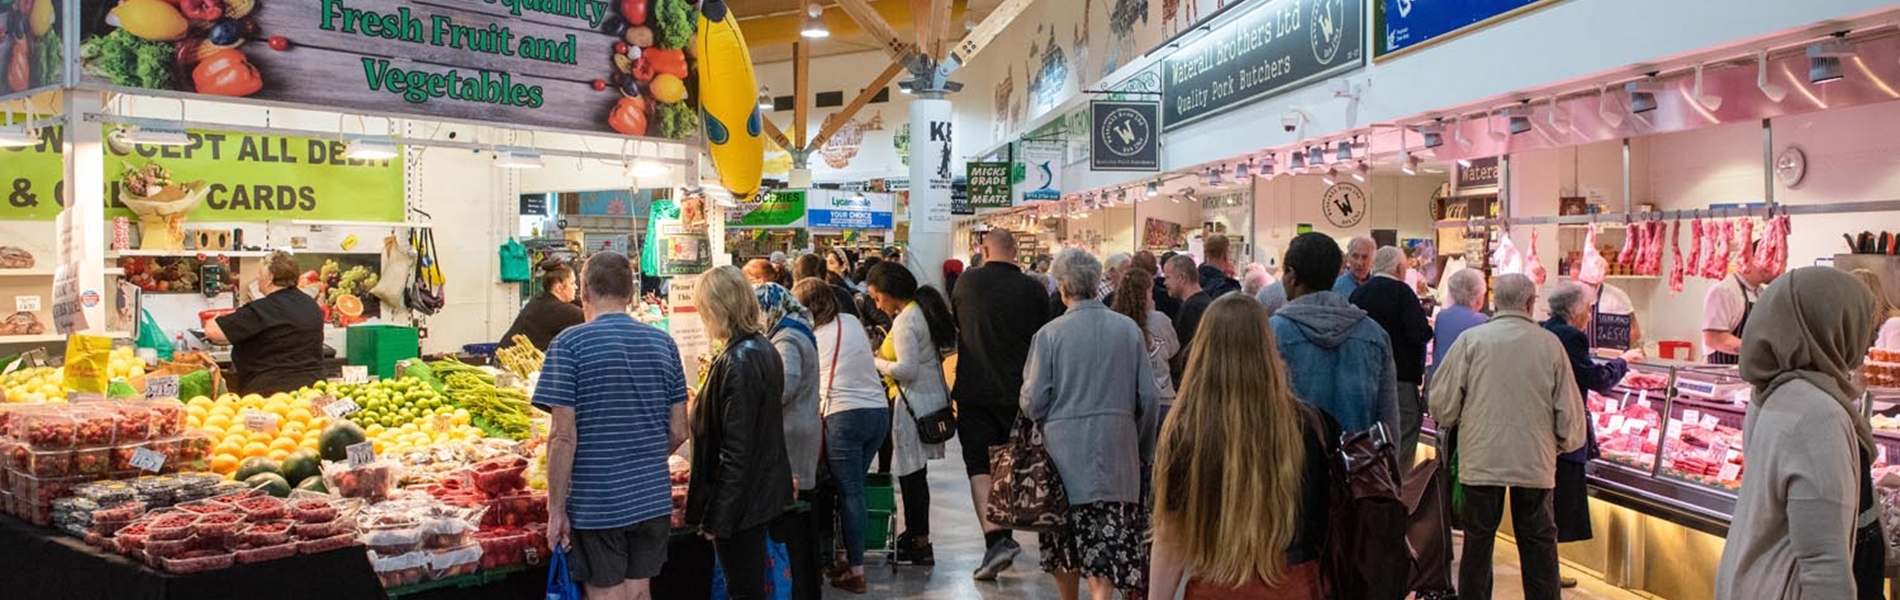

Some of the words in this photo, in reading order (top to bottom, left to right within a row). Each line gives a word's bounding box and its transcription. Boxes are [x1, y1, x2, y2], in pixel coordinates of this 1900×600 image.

[320, 0, 425, 43] Fresh
[431, 15, 515, 56] Fruit
[518, 34, 577, 65] and
[1172, 51, 1214, 86] Waterall
[1216, 21, 1272, 66] Brothers
[1275, 3, 1300, 38] Ltd
[361, 57, 544, 108] Vegetables
[1176, 84, 1208, 116] Quality
[1211, 75, 1234, 101] Pork
[1239, 54, 1291, 90] Butchers
[1112, 120, 1135, 145] W
[237, 135, 297, 163] ALL
[970, 176, 1007, 186] GRADE
[971, 167, 1007, 176] MICKS
[8, 177, 38, 208] &
[206, 183, 316, 211] CARDS
[970, 195, 1008, 204] MEATS
[984, 186, 993, 195] A
[1333, 193, 1353, 216] W
